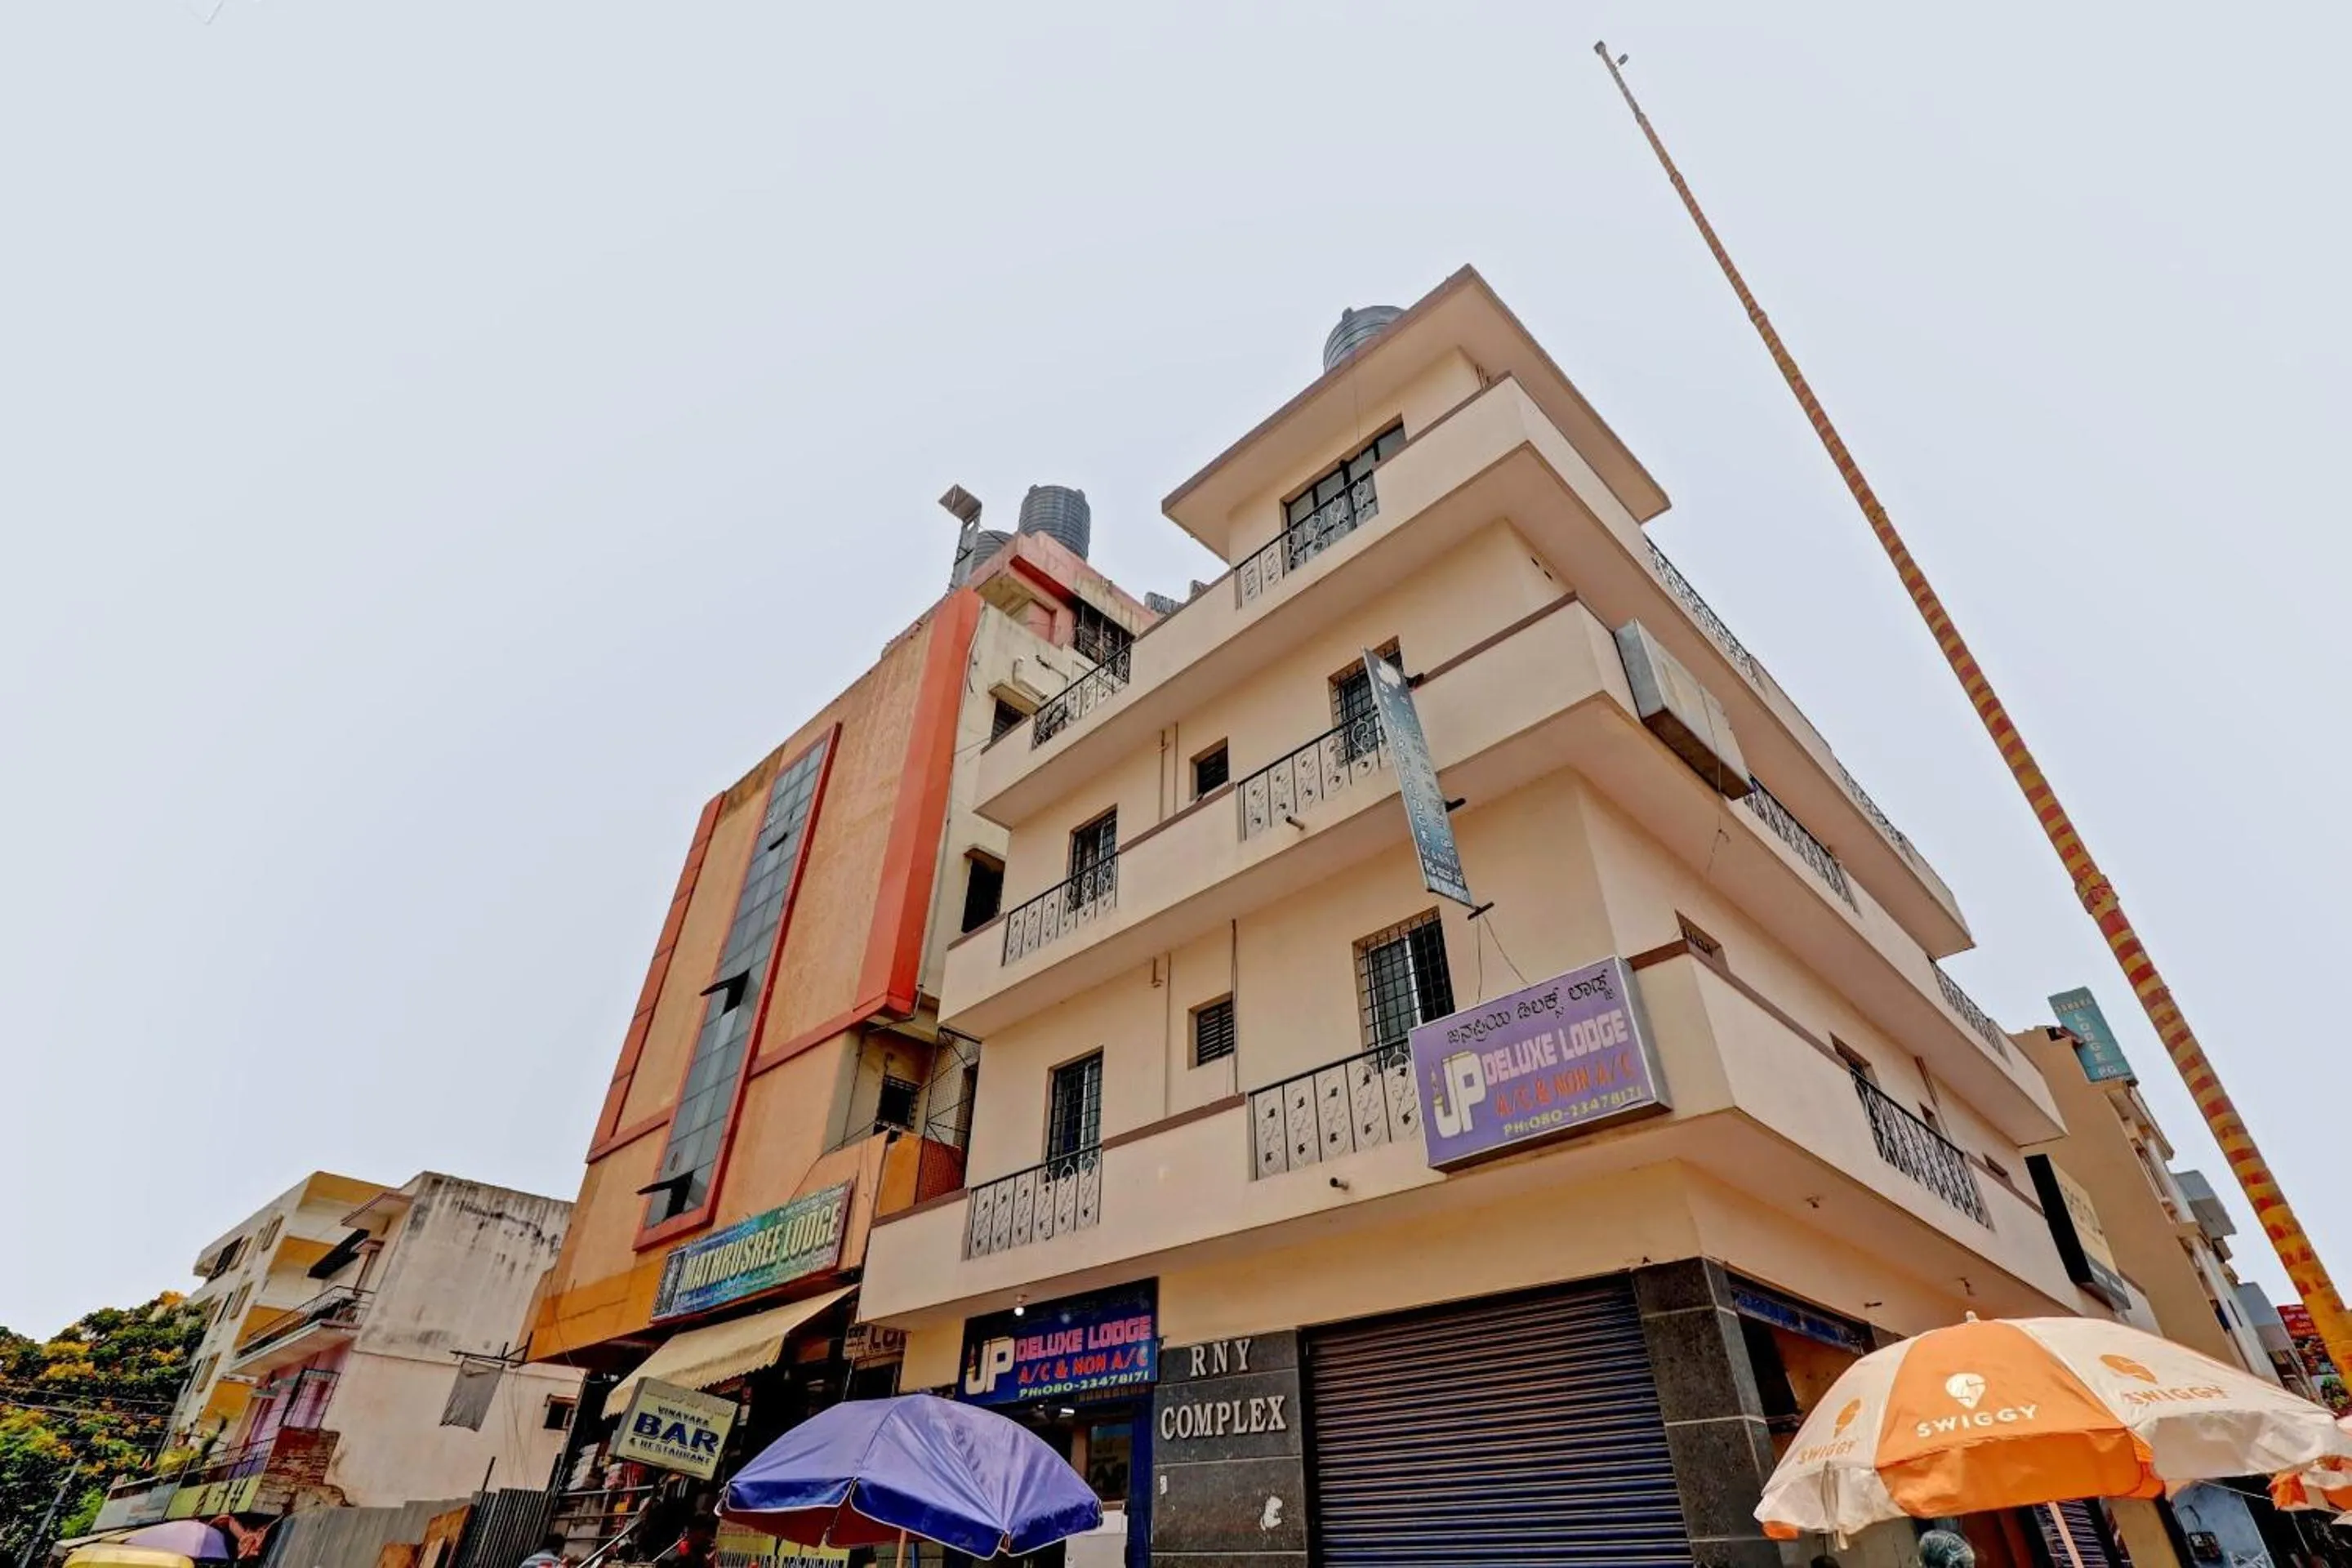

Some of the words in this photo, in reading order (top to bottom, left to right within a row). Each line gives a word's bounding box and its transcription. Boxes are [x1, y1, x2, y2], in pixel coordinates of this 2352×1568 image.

[1481, 1032, 1559, 1086] DELUXE
[1558, 1009, 1630, 1056] LODGE
[1433, 1050, 1486, 1138] JP
[1496, 1084, 1532, 1118] A/C
[1535, 1076, 1551, 1104] &
[1554, 1063, 1591, 1095] NON
[1595, 1051, 1636, 1085] A/C
[679, 1227, 782, 1292] MATHRUSREE
[782, 1201, 842, 1259] LODGE
[1016, 1327, 1084, 1363] DELUXE
[1088, 1315, 1152, 1350] LODGE
[1189, 1338, 1252, 1378] RNY
[965, 1335, 1016, 1396] JP
[1018, 1361, 1051, 1386] A/C
[1054, 1359, 1069, 1379] &
[1073, 1353, 1107, 1376] NON
[1111, 1347, 1148, 1368] A/C
[2123, 1385, 2228, 1405] SWIGGY
[632, 1411, 719, 1456] BAR
[1160, 1395, 1288, 1442] COMPLEX
[1914, 1403, 2042, 1439] SWIGGY
[639, 1438, 710, 1465] RESTAURANT
[1798, 1439, 1859, 1463] SWIGGY
